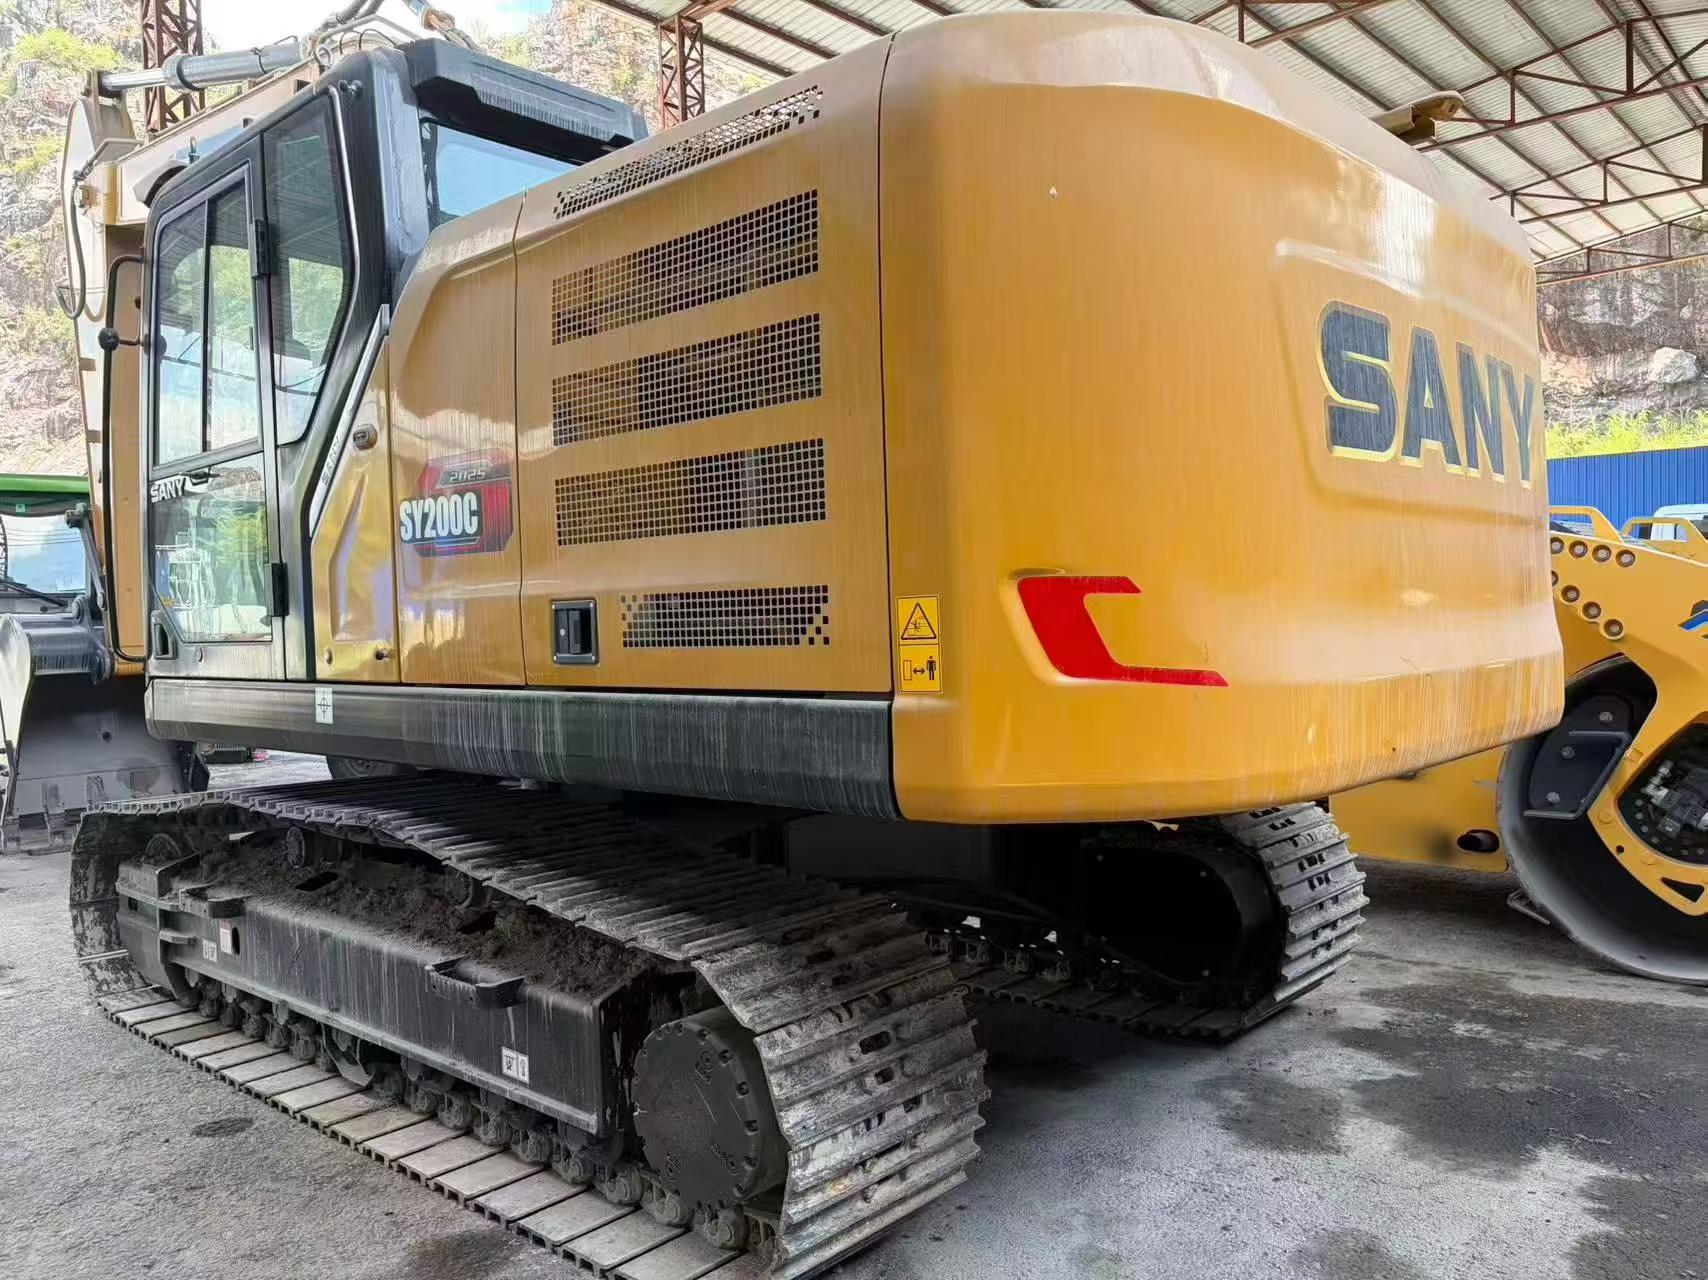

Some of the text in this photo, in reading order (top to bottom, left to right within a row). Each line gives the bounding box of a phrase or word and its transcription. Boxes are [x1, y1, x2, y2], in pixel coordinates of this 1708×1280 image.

[1316, 300, 1535, 488] SANY
[151, 478, 184, 502] SANY
[400, 492, 478, 541] SY200C
